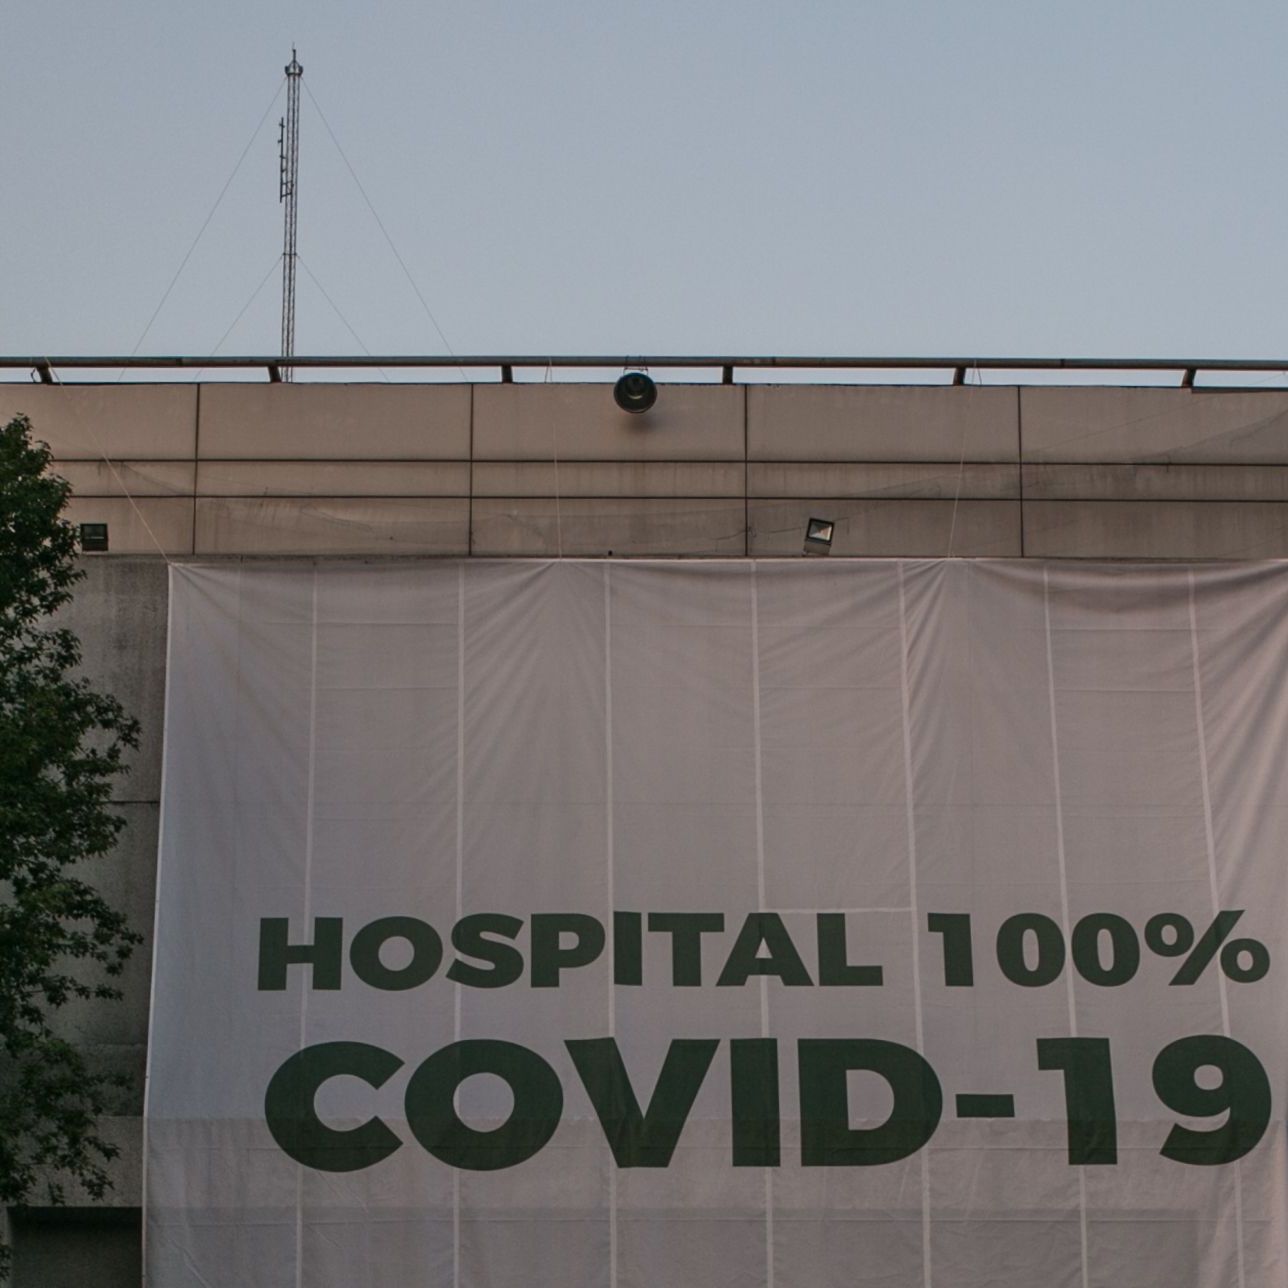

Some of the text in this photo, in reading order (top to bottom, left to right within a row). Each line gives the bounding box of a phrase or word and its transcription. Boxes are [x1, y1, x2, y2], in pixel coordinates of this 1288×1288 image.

[257, 908, 1271, 991] HOSPITAL 100%
[264, 1034, 1273, 1174] COVID-19
